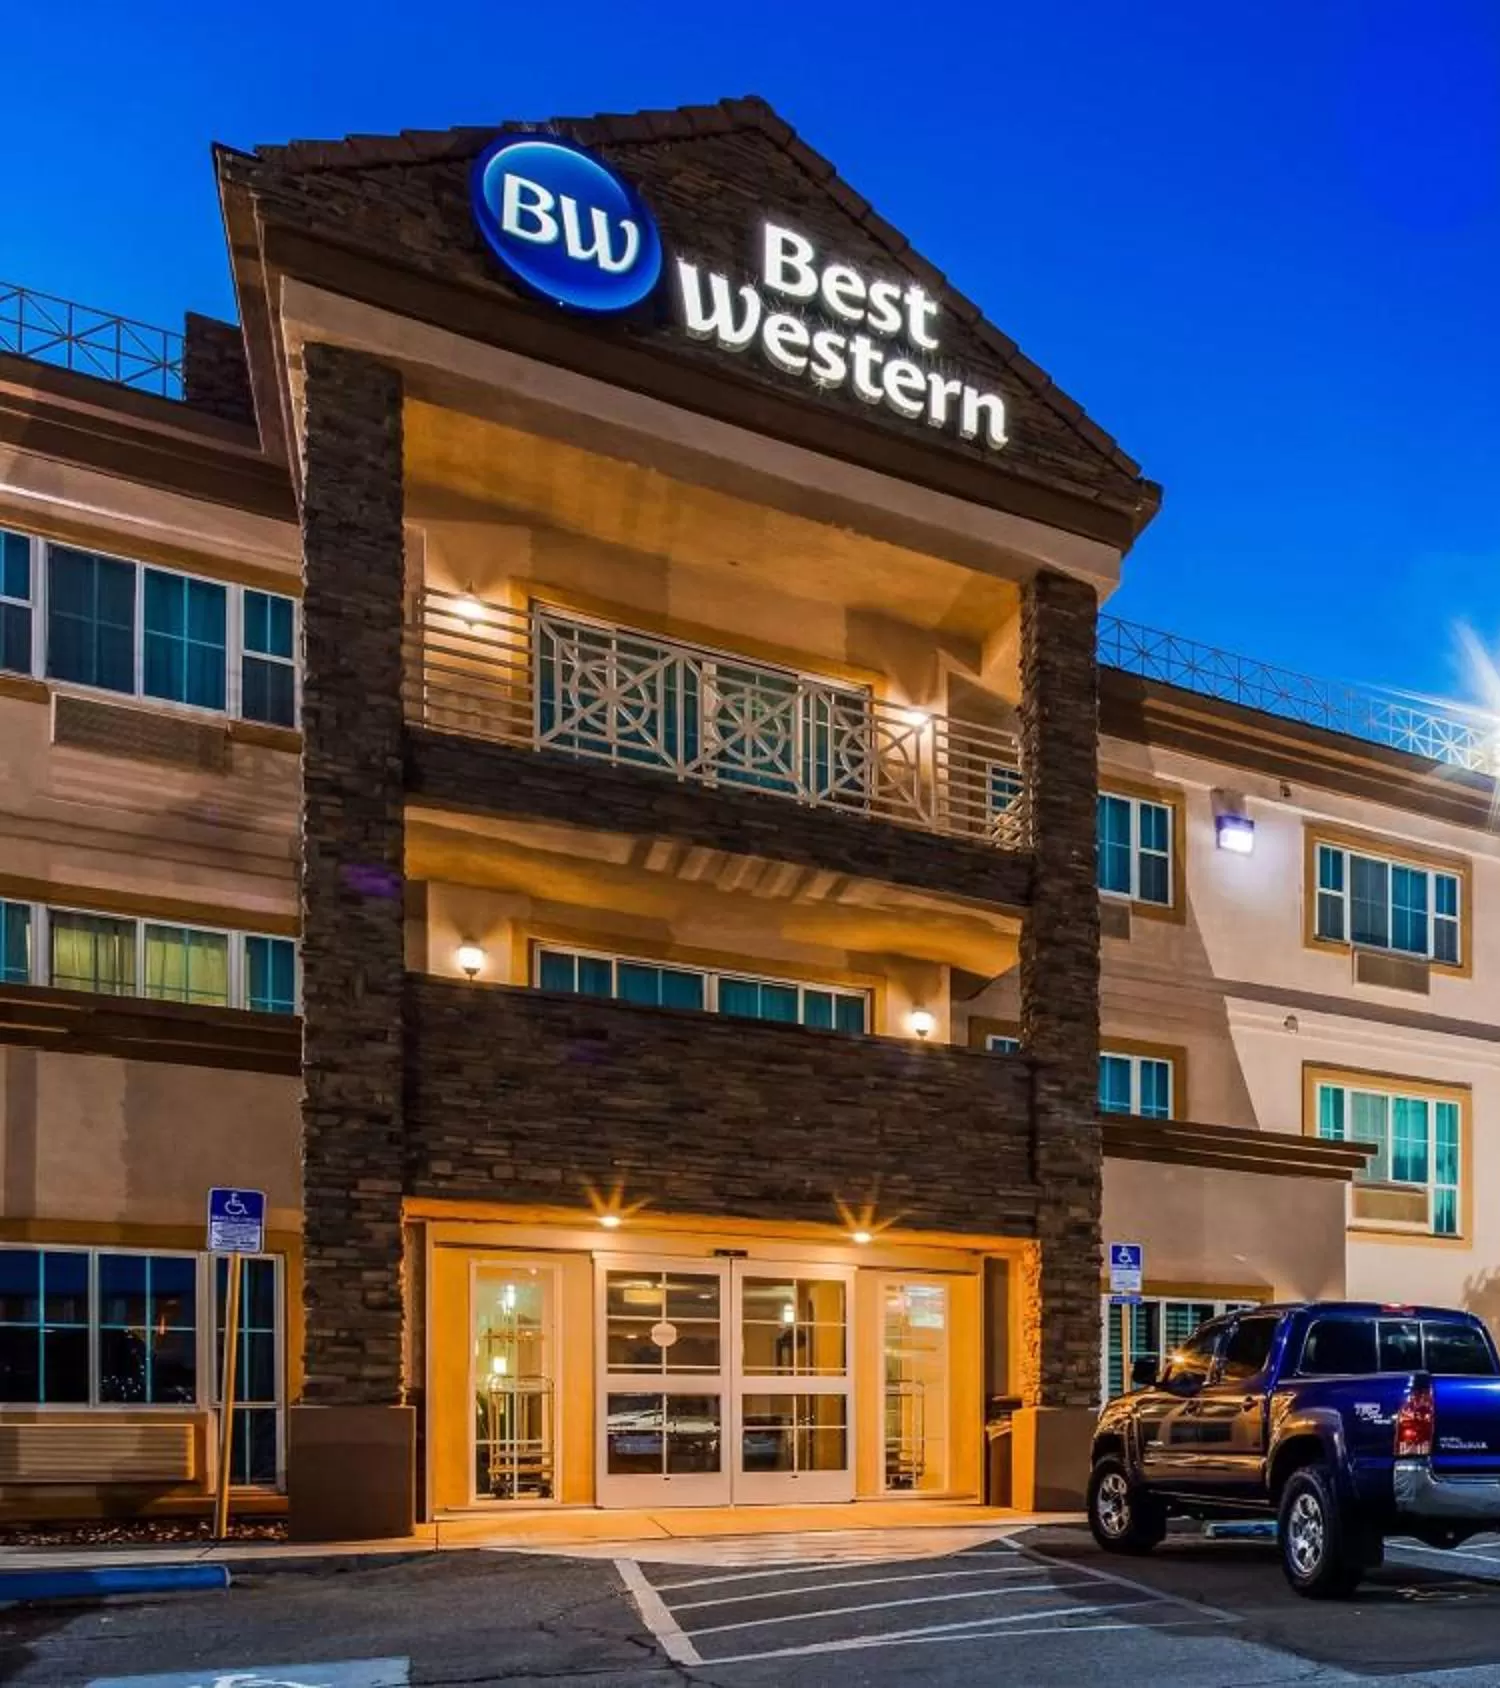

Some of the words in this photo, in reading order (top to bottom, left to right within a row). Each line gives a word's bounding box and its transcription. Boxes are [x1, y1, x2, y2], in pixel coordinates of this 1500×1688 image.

[502, 173, 640, 273] BW
[762, 221, 938, 350] Best
[676, 258, 1010, 450] Western
